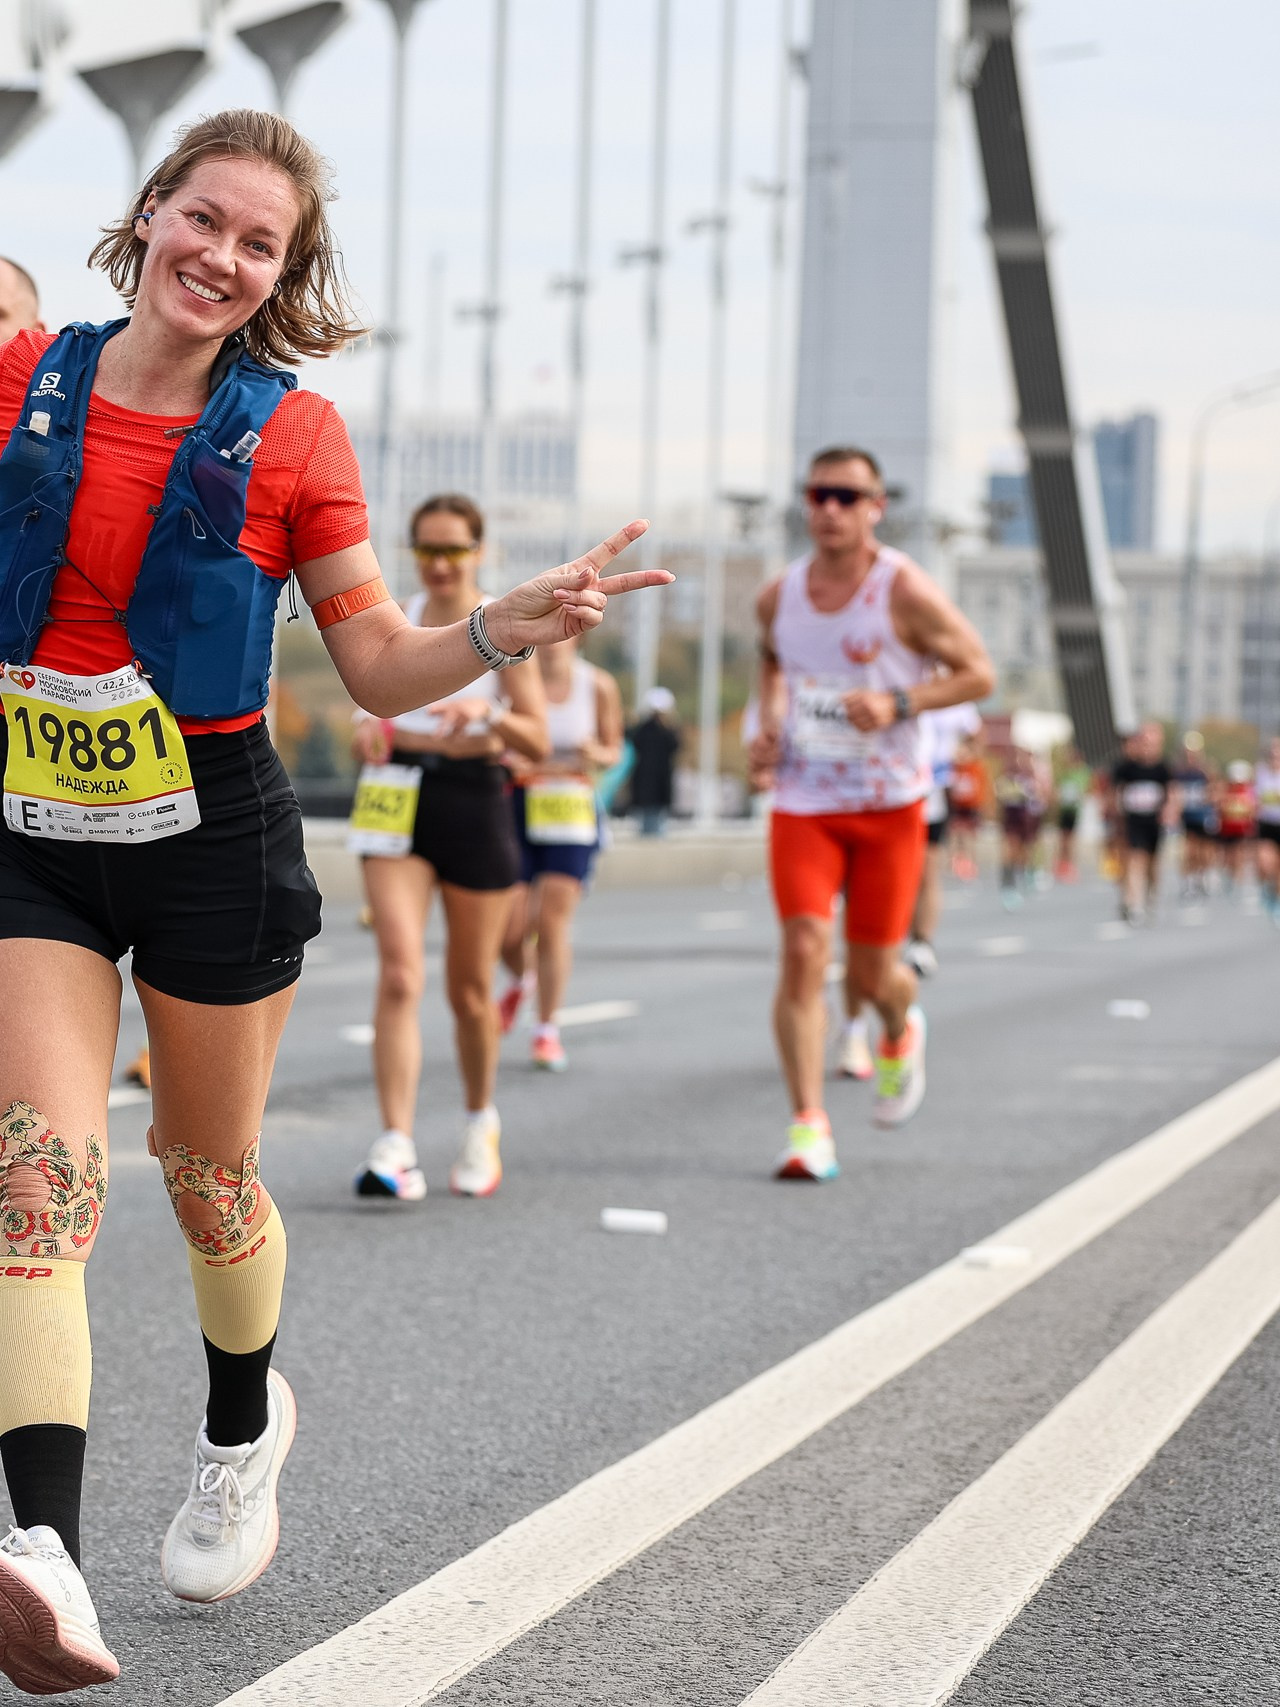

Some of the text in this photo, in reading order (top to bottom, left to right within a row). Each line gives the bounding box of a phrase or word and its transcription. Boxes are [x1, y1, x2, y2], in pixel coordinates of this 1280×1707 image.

[37, 672, 74, 688] СБЕРПРАЙМ
[39, 679, 92, 697] МОСКОВСКИЙ
[40, 688, 78, 704] МАРАФОН
[14, 706, 168, 773] 19881
[167, 769, 174, 777] 1
[55, 772, 130, 796] НАДЕЖДА
[21, 800, 42, 832] E
[137, 809, 156, 818] СБЕР
[205, 1235, 267, 1267] cep
